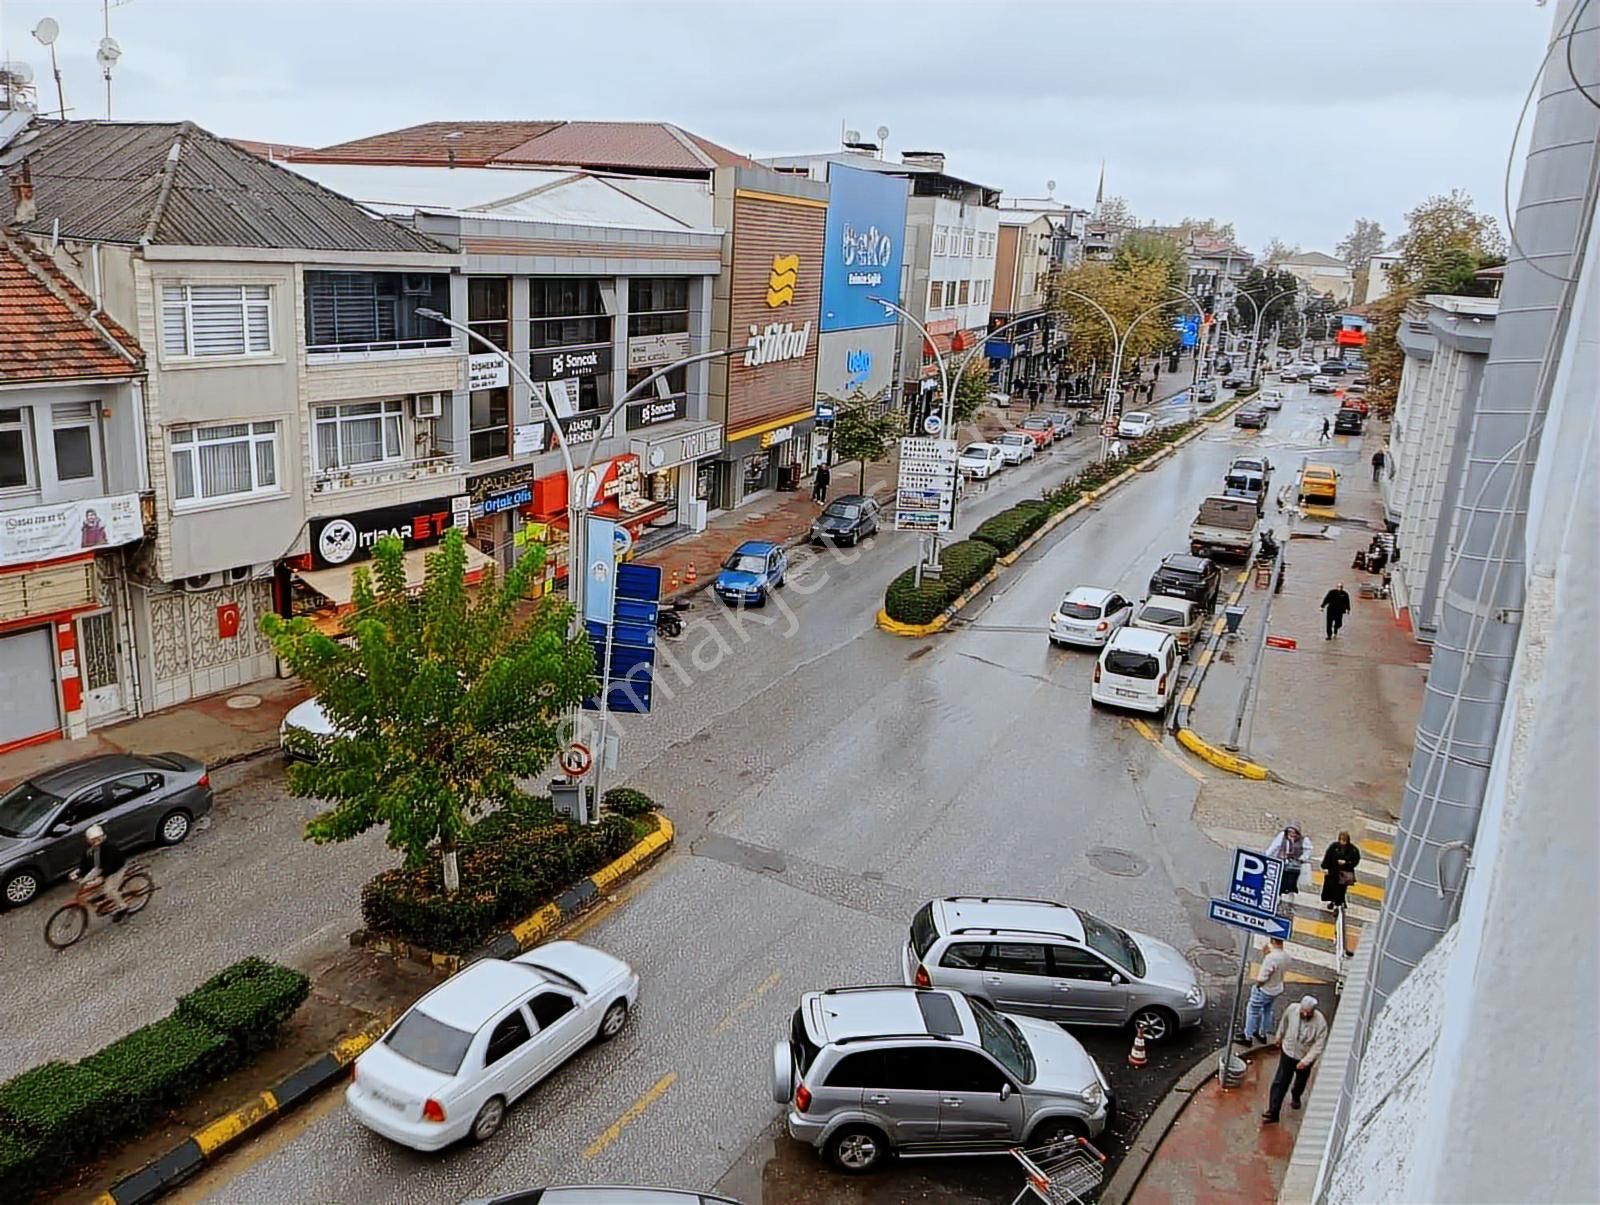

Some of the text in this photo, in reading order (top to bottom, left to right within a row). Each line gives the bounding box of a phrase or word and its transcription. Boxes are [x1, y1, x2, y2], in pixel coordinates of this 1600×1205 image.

[565, 351, 598, 368] Sancak
[650, 399, 677, 416] Sancak
[485, 494, 512, 512] Ortak
[513, 489, 532, 504] Ofis
[1236, 853, 1265, 881] P
[1235, 884, 1256, 896] PARK
[1218, 909, 1239, 920] TEK
